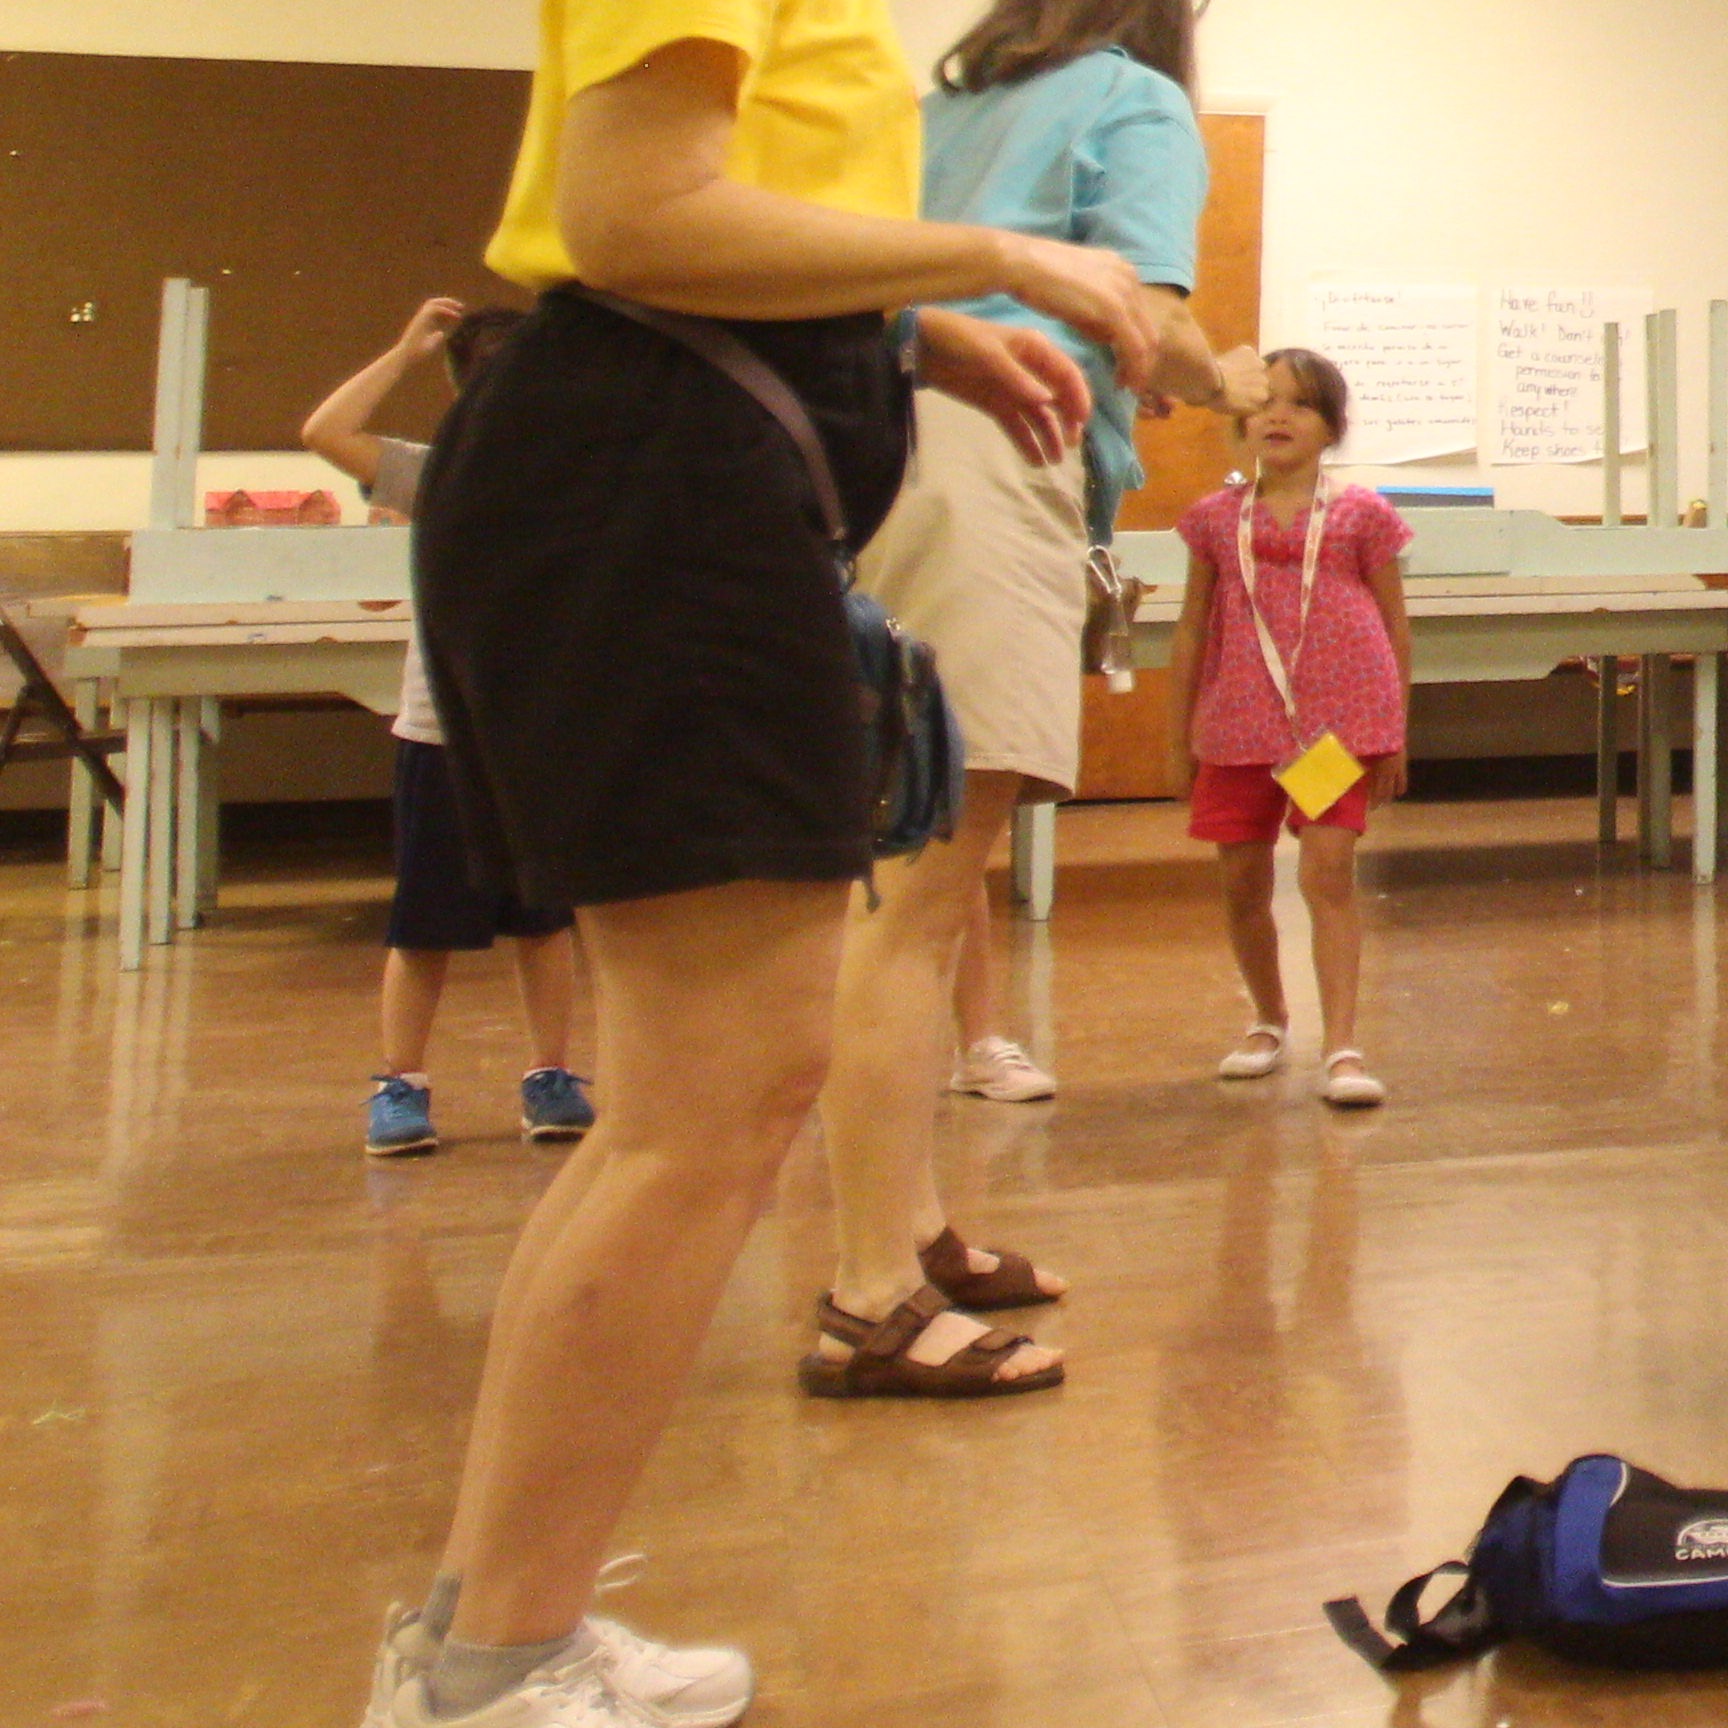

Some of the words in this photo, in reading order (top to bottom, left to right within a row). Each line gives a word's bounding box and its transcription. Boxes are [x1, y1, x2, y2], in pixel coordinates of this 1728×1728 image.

[1500, 289, 1539, 312] Have
[1558, 324, 1593, 343] Don't
[1497, 342, 1523, 360] Get
[1515, 365, 1582, 381] permission
[1500, 420, 1555, 438] Hands
[1502, 438, 1541, 461] Keep
